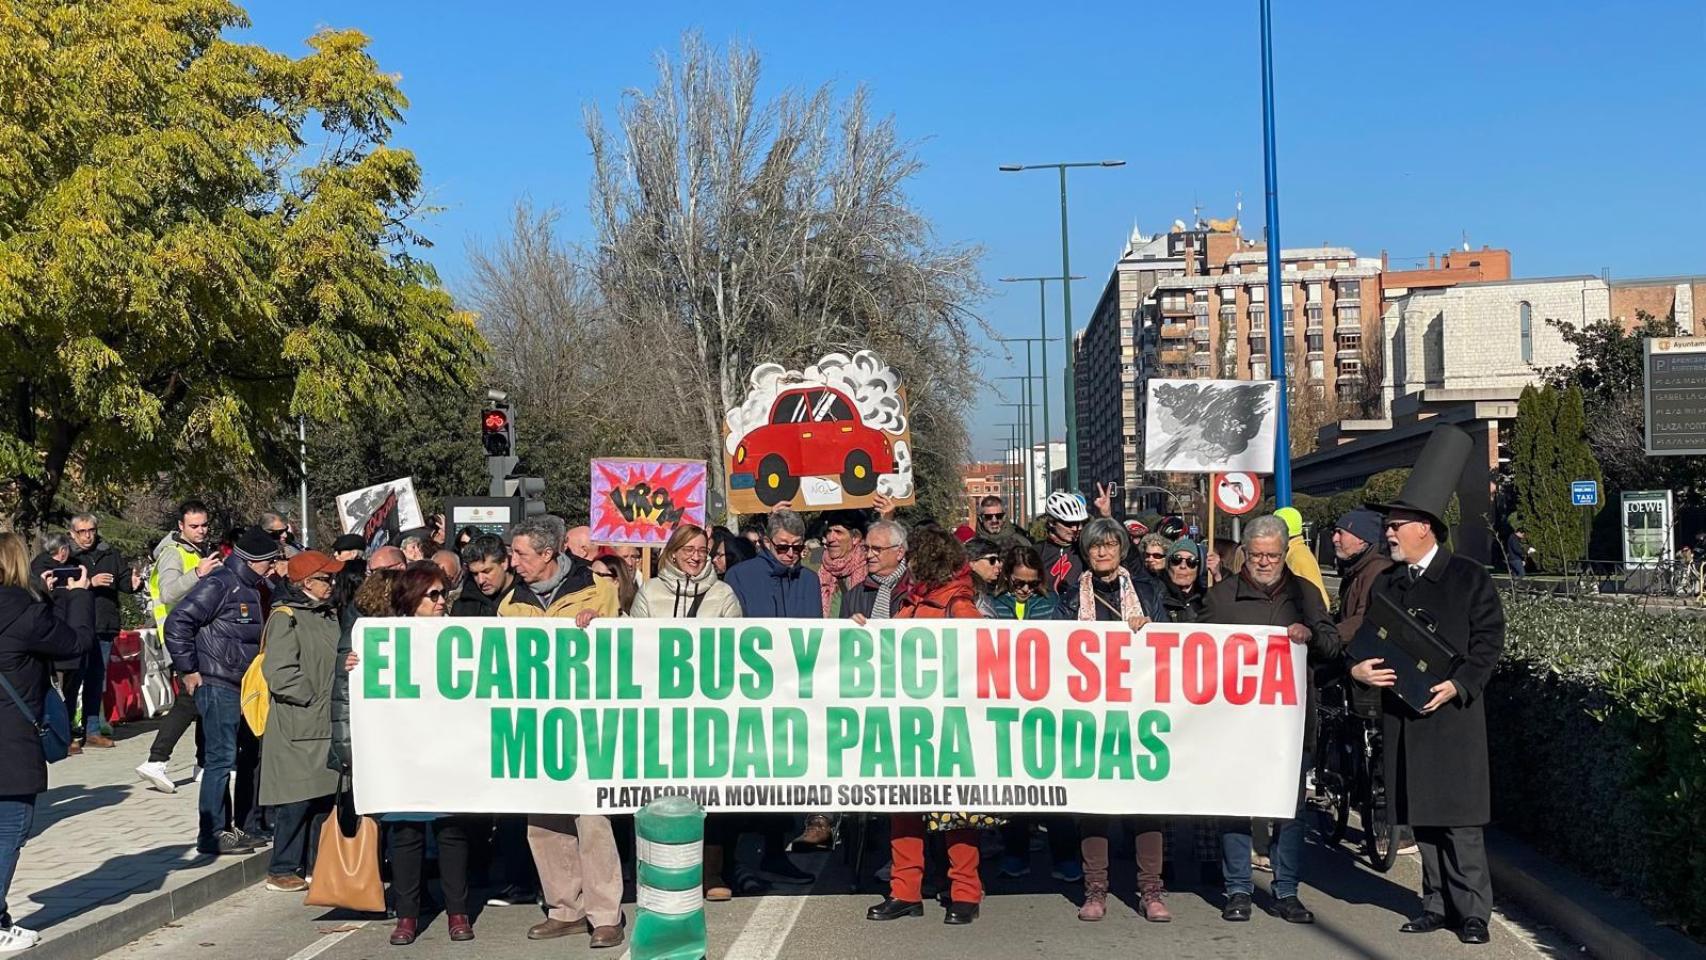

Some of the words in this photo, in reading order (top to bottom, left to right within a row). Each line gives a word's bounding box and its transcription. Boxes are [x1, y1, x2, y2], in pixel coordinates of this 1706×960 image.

[1627, 502, 1662, 512] LOEWE
[362, 626, 421, 700] EL
[435, 624, 644, 701] CARRIL
[658, 625, 775, 701] BUS
[788, 627, 824, 700] Y
[838, 627, 960, 700] BICI
[976, 628, 1051, 701] NO
[1066, 629, 1133, 704] SE
[1145, 632, 1298, 706] TOCA
[490, 706, 810, 782] MOVILIDAD
[825, 706, 977, 779] PARA
[985, 707, 1173, 782] TODAS
[725, 785, 832, 807] MOVILIDAD
[837, 784, 953, 807] SOSTENIBLE
[956, 784, 1068, 807] VALLADOLID
